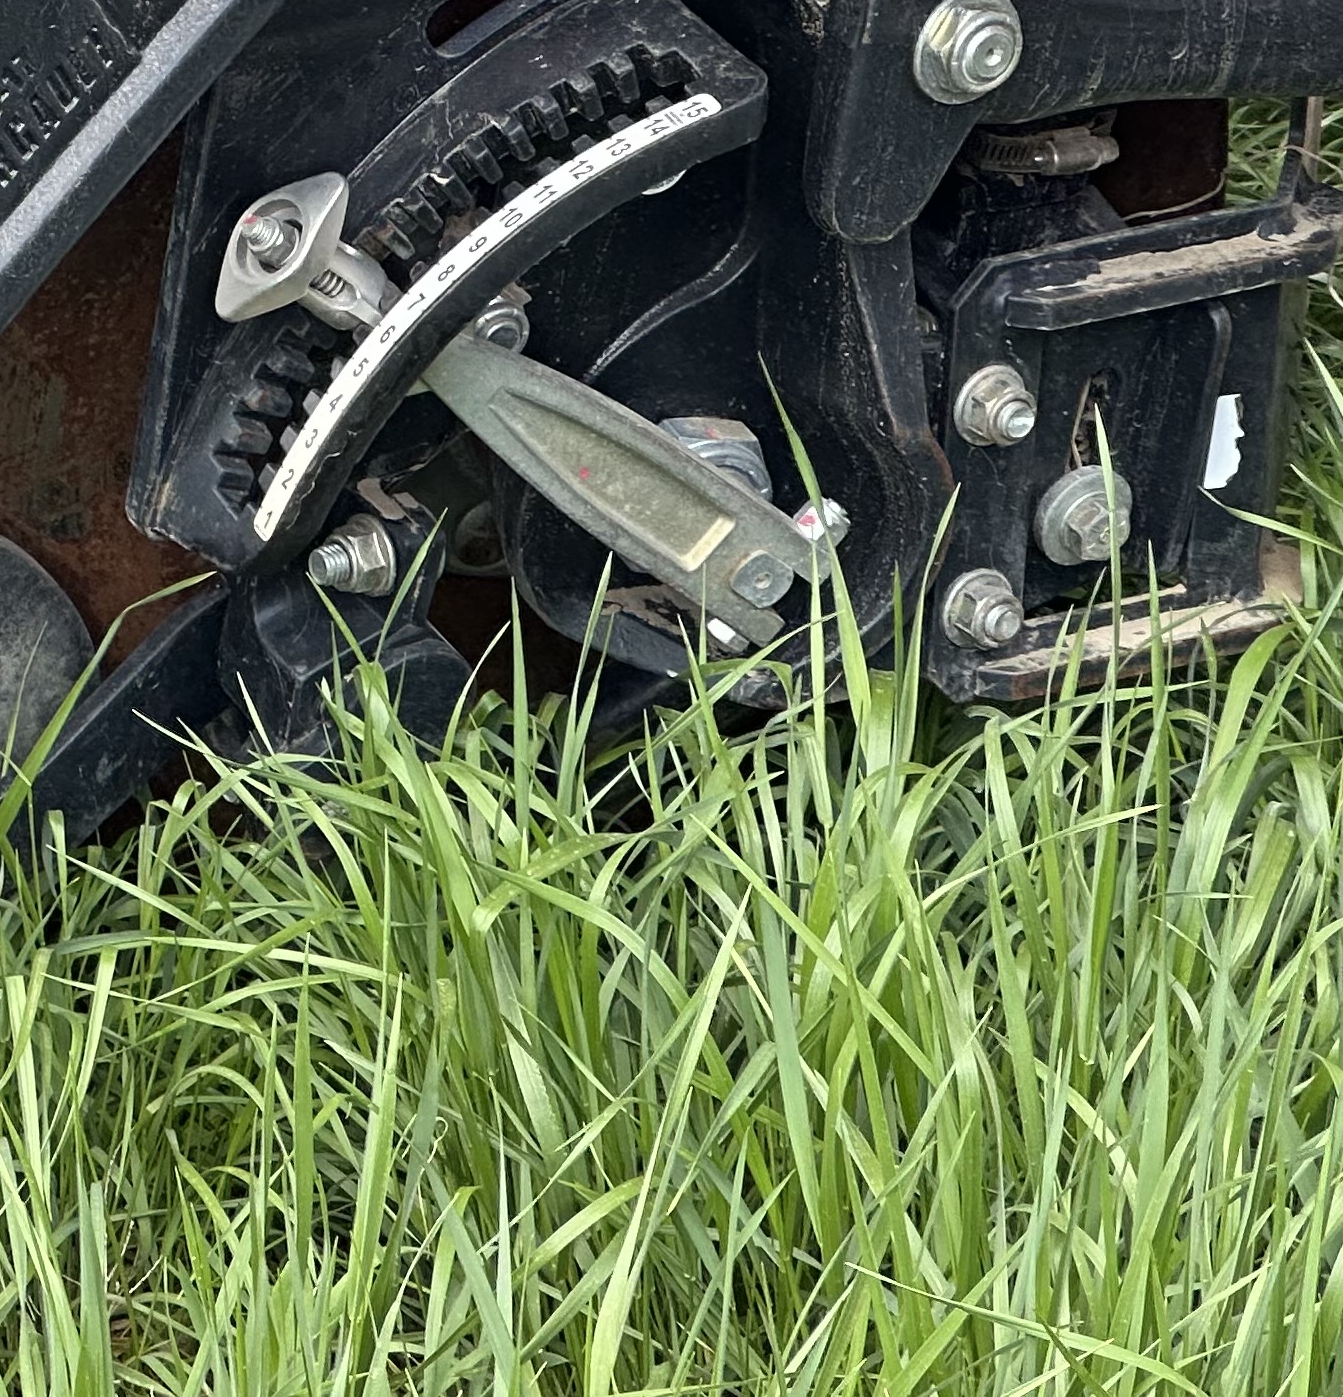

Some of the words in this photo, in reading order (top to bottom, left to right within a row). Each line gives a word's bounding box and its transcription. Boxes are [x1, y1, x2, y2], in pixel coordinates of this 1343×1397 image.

[264, 511, 274, 529] 1
[281, 469, 295, 489] 2
[305, 429, 318, 448] 3
[329, 395, 343, 413] 4
[353, 358, 369, 377] 5
[380, 325, 396, 343] 6
[408, 293, 426, 310] 7
[438, 264, 456, 282] 8
[469, 237, 488, 252] 9
[499, 208, 524, 228] 10
[534, 185, 558, 204] 11
[570, 160, 594, 180] 12
[607, 138, 632, 156] 13
[644, 119, 670, 136] 14
[682, 102, 708, 118] 15
